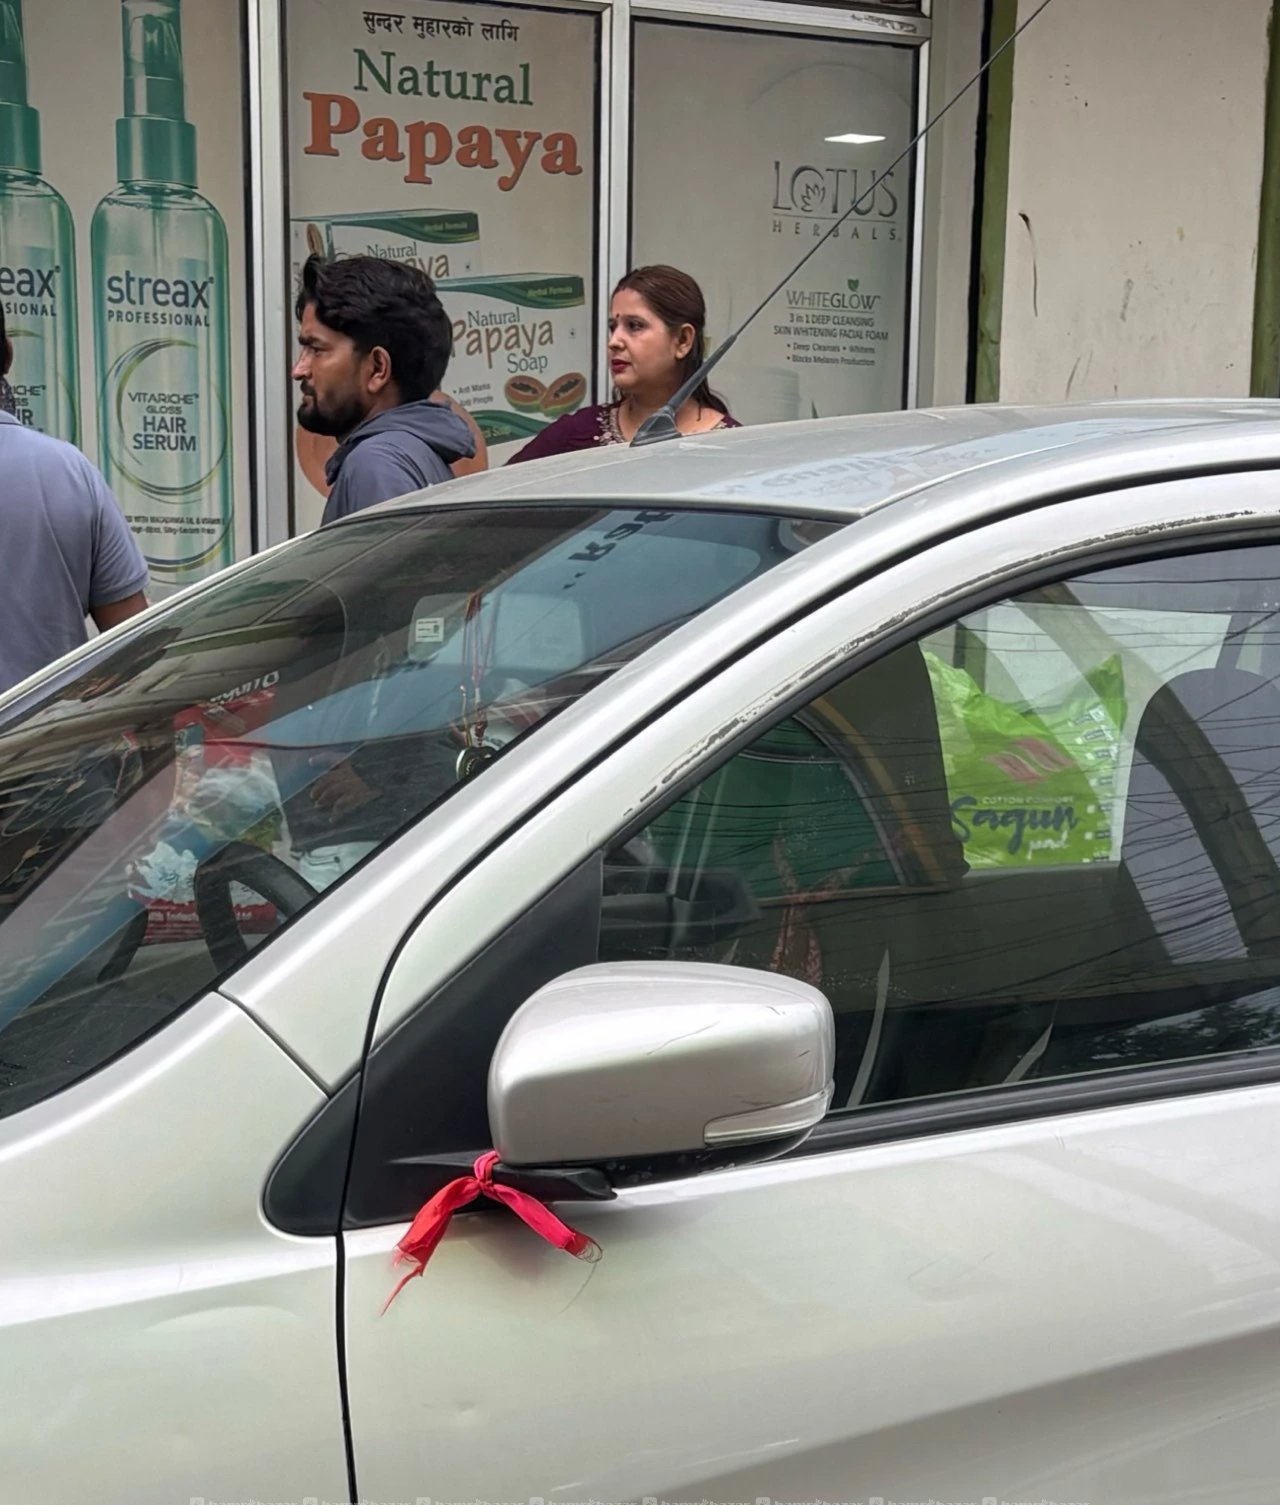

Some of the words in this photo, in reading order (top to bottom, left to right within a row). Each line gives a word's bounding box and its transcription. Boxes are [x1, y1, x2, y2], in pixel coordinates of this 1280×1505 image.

[363, 11, 405, 34] सुन्दर
[412, 15, 472, 39] मुहारको
[481, 20, 519, 41] लागि
[353, 48, 533, 106] Natural
[303, 92, 583, 191] Papaya
[772, 219, 897, 240] HERBALS
[107, 270, 210, 309] streax
[786, 289, 876, 310] WHITEGLOW
[107, 309, 210, 328] PROFESSIONAL
[467, 306, 520, 328] Natural
[811, 314, 831, 326] DEEP
[832, 317, 874, 328] CLEANSING
[773, 324, 792, 336] SKIN
[793, 326, 838, 339] WHITENING
[839, 329, 864, 340] FACIAL
[865, 331, 888, 341] FOAM
[507, 352, 548, 374] Soap
[128, 392, 194, 405] VITARICHE
[146, 406, 182, 415] GLOSS
[143, 416, 187, 434] HAIR
[133, 434, 196, 452] SERUM
[951, 796, 1078, 855] Sagun
